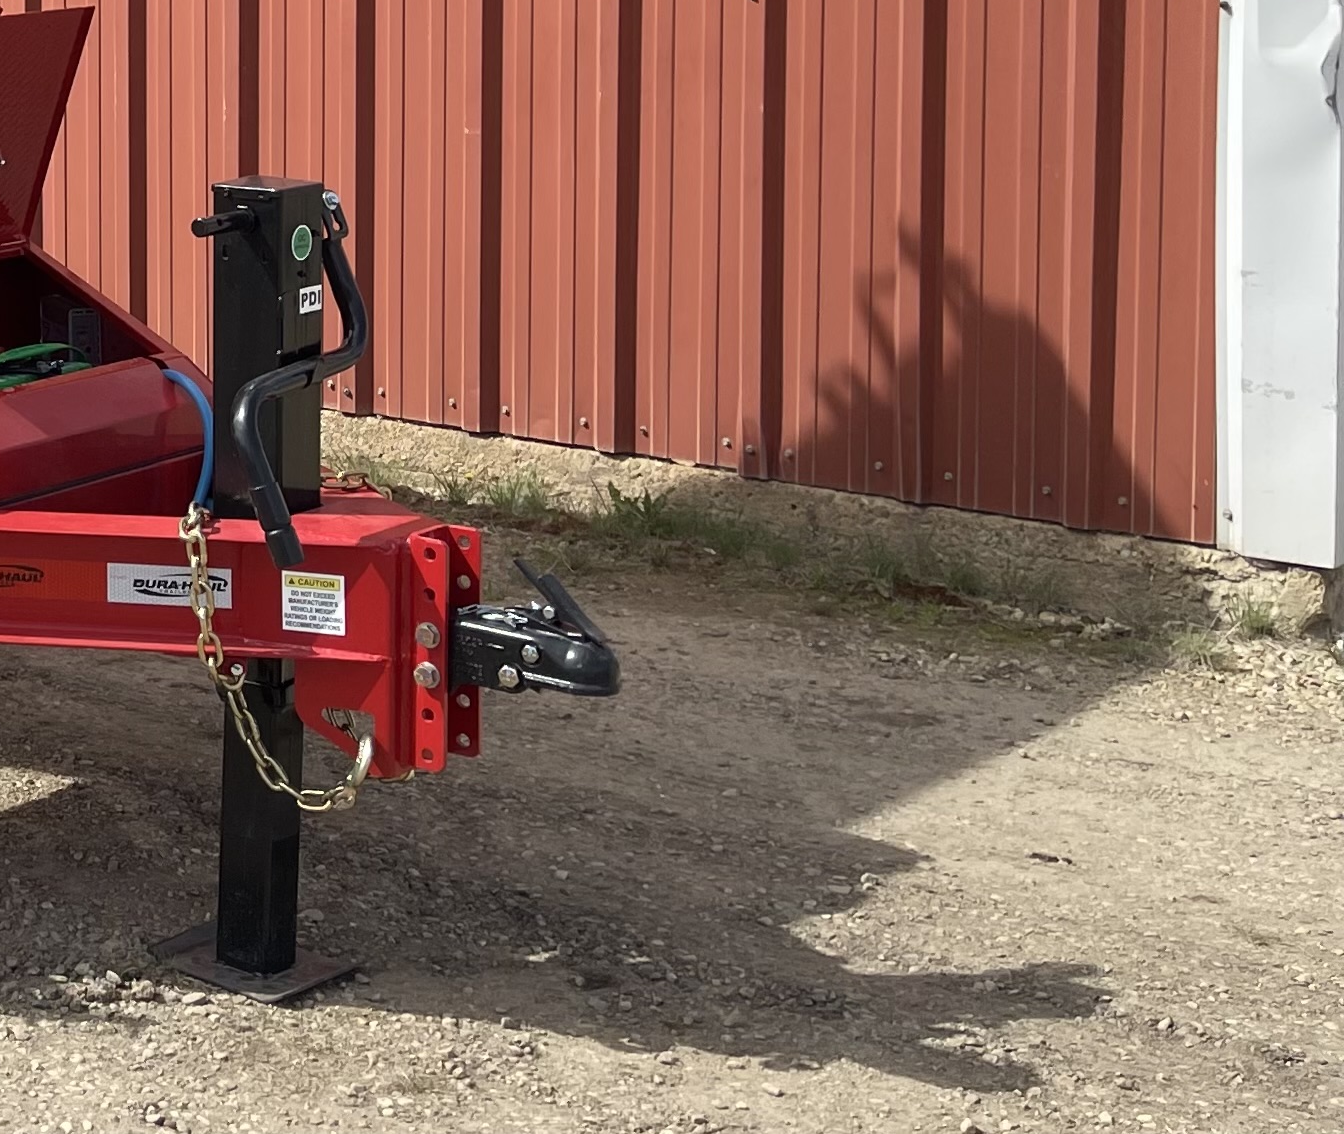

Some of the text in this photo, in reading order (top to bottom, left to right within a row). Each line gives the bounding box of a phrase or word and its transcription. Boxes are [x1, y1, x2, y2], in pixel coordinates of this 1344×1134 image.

[301, 289, 321, 308] PDI
[133, 578, 227, 593] DURA-HL
[297, 577, 336, 588] CAUTION
